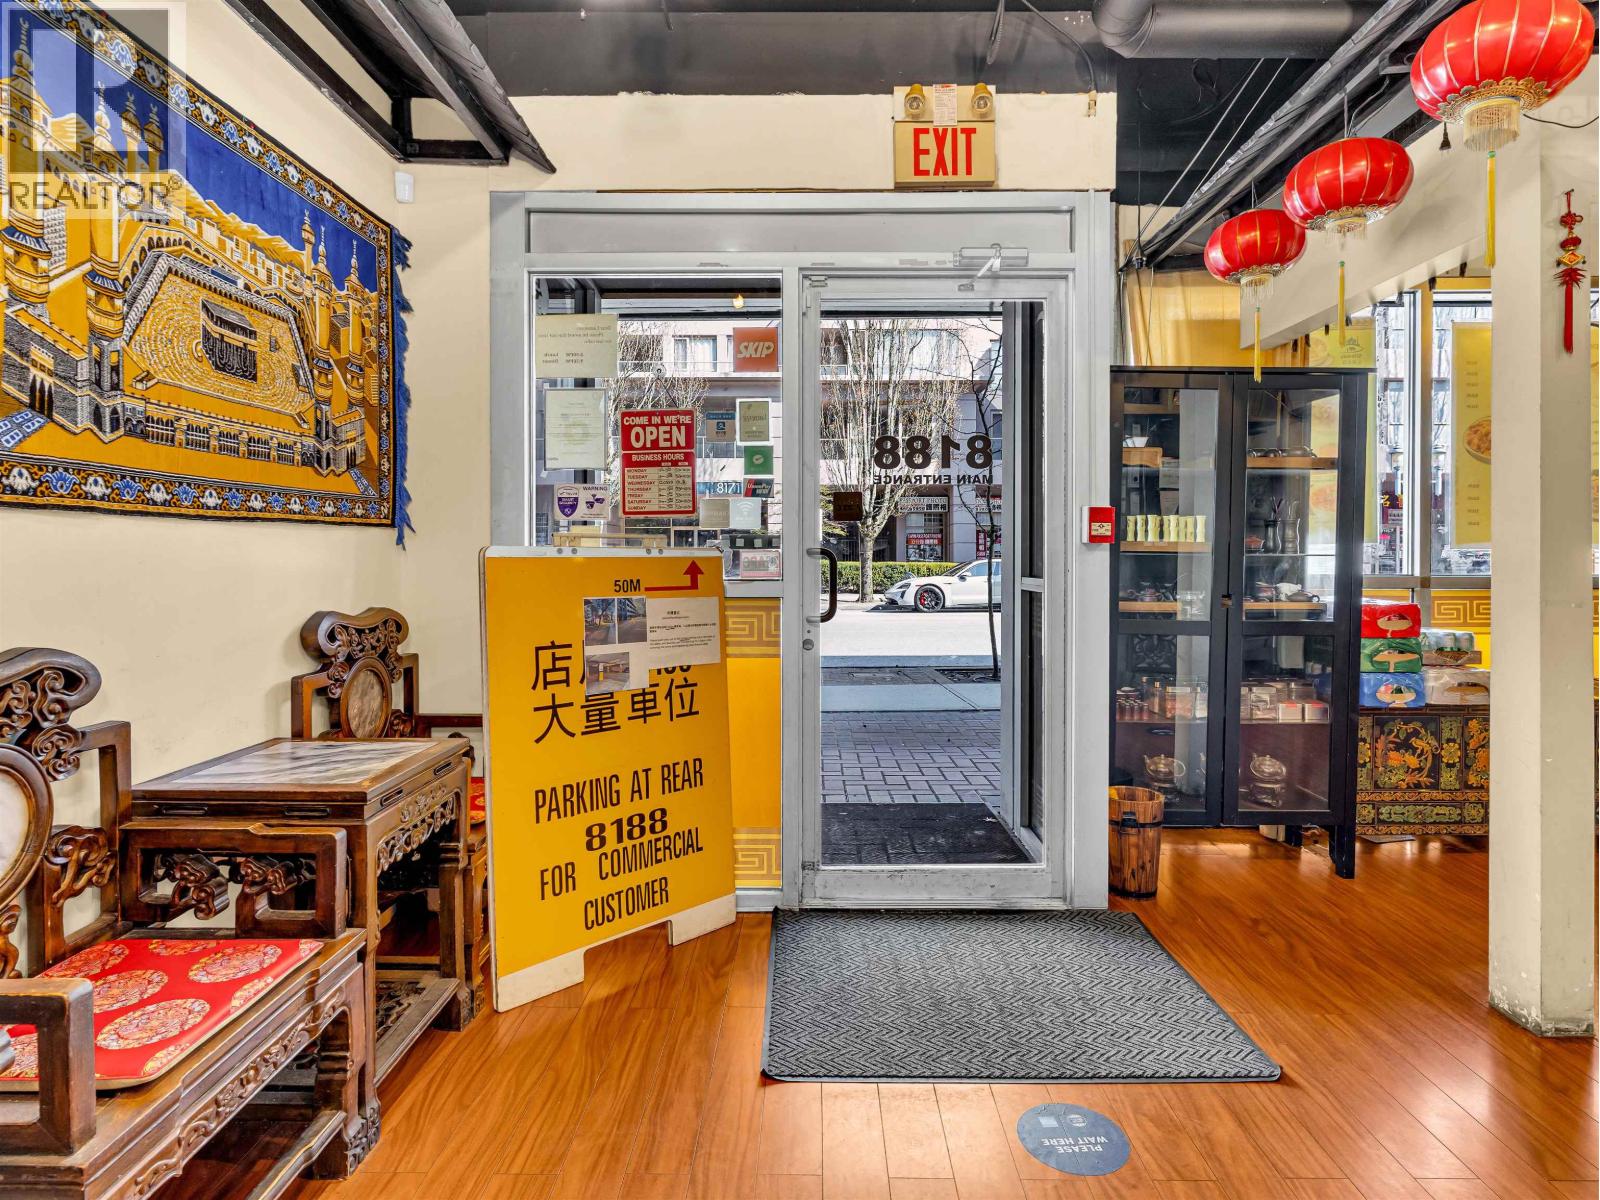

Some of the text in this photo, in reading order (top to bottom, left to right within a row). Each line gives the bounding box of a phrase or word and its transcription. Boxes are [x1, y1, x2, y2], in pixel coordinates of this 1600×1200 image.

[913, 127, 977, 176] EXIT
[736, 341, 775, 358] SKIP
[623, 414, 692, 425] COME IN WE'RE
[630, 425, 686, 448] OPEN
[632, 453, 685, 462] BUSINESS HOURS
[716, 482, 741, 494] 8171
[613, 579, 641, 593] 50M
[531, 640, 585, 691] 店
[533, 677, 700, 744] 大量車位
[534, 757, 704, 824] PARKING AT REAR
[585, 807, 668, 852] 8188
[540, 827, 704, 900] FOR COMMERCIAL
[584, 876, 669, 931] CUSTOMER
[1041, 1135, 1109, 1146] WAIT HERE
[1056, 1144, 1104, 1154] PLEASE
